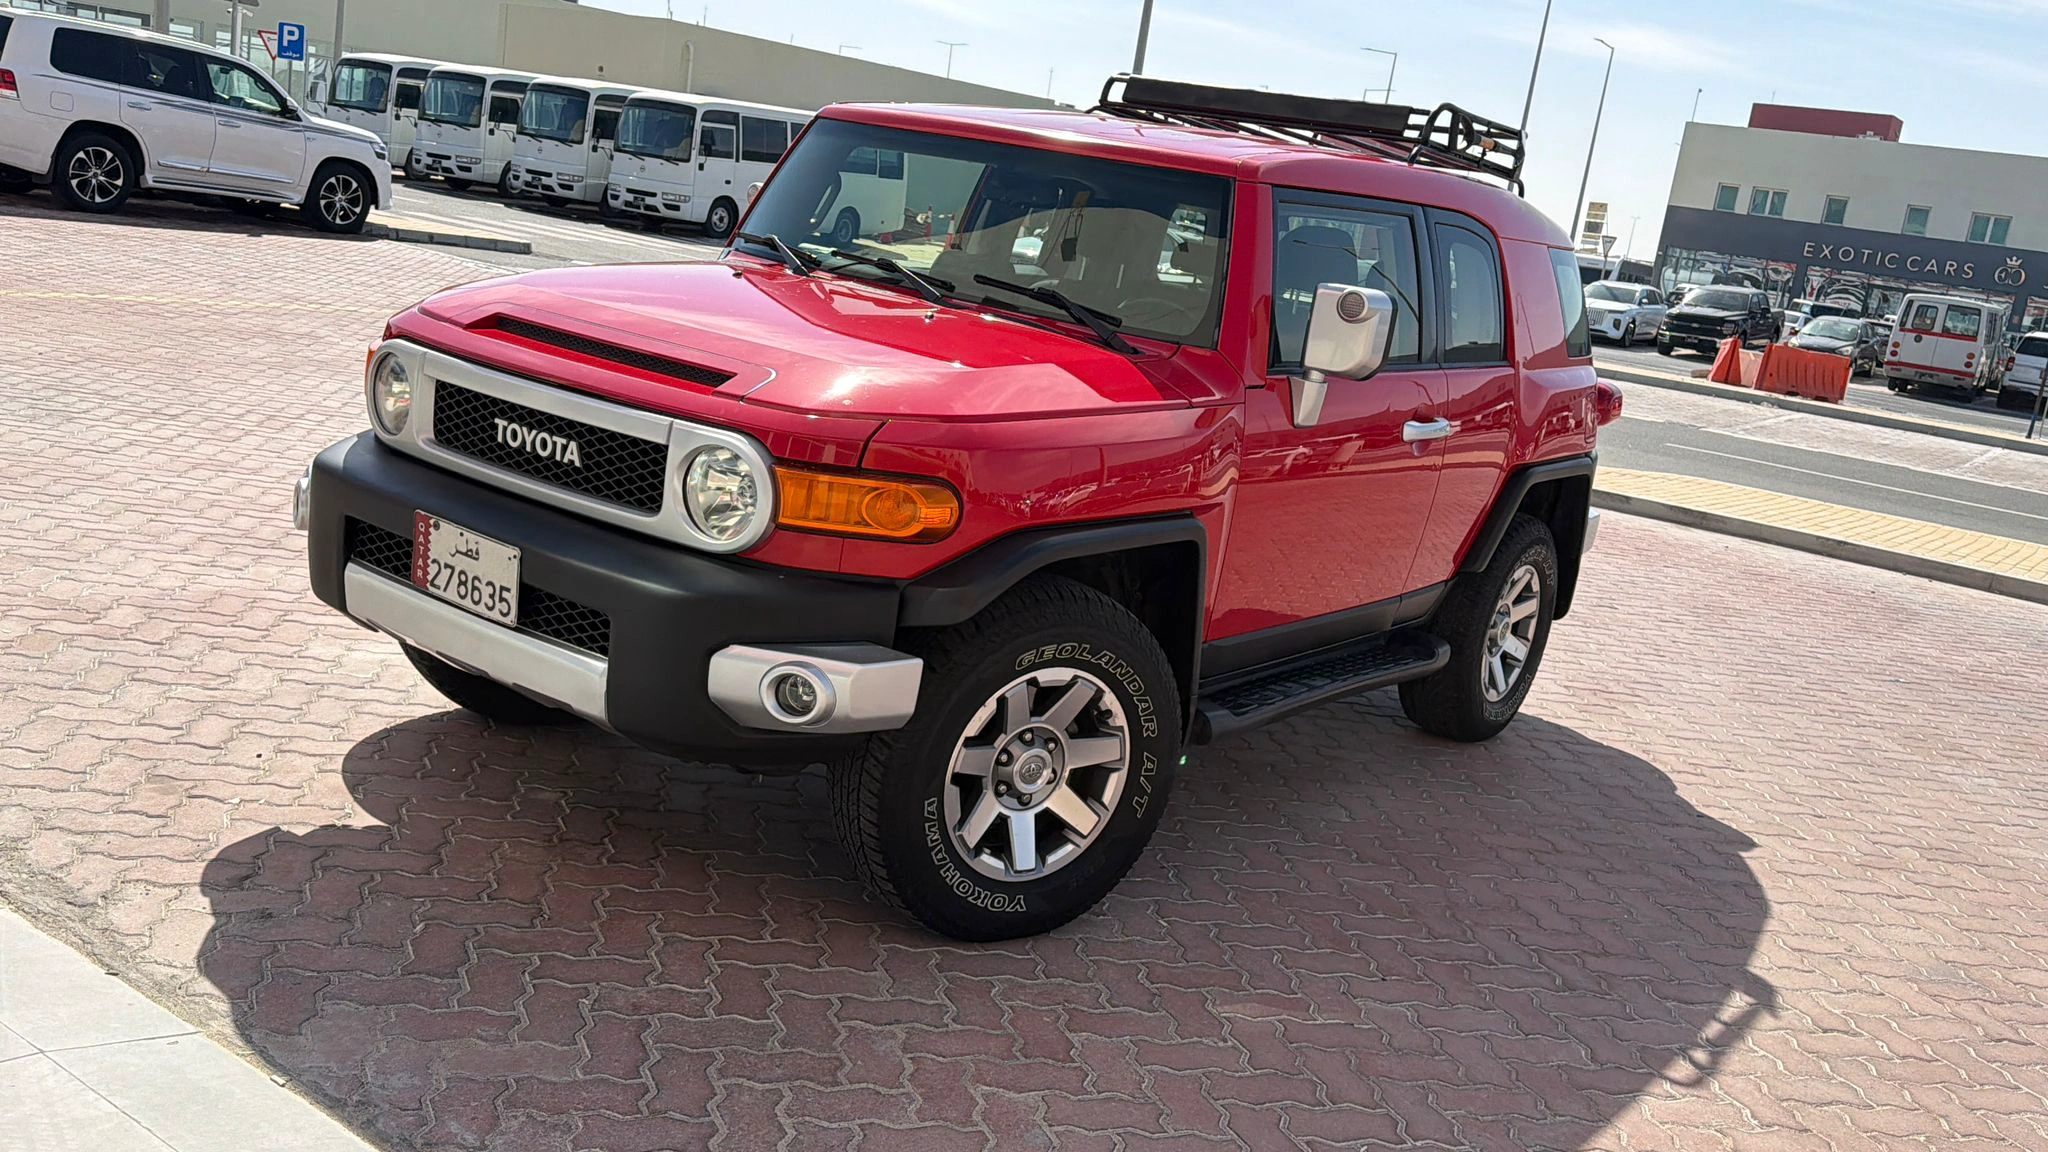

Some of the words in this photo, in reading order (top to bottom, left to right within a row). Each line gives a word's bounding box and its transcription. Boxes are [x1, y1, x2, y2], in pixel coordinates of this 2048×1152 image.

[283, 25, 299, 47] P
[1803, 242, 1899, 269] EXOTIC
[1906, 255, 1975, 279] CARS
[494, 418, 581, 467] TOYOTA
[417, 522, 425, 579] QATAR
[448, 538, 480, 561] قطر
[429, 558, 511, 617] 278635
[1015, 643, 1157, 738] GEOLANDAR
[1132, 751, 1157, 818] A/T
[924, 797, 1026, 912] YOKOHAMA
